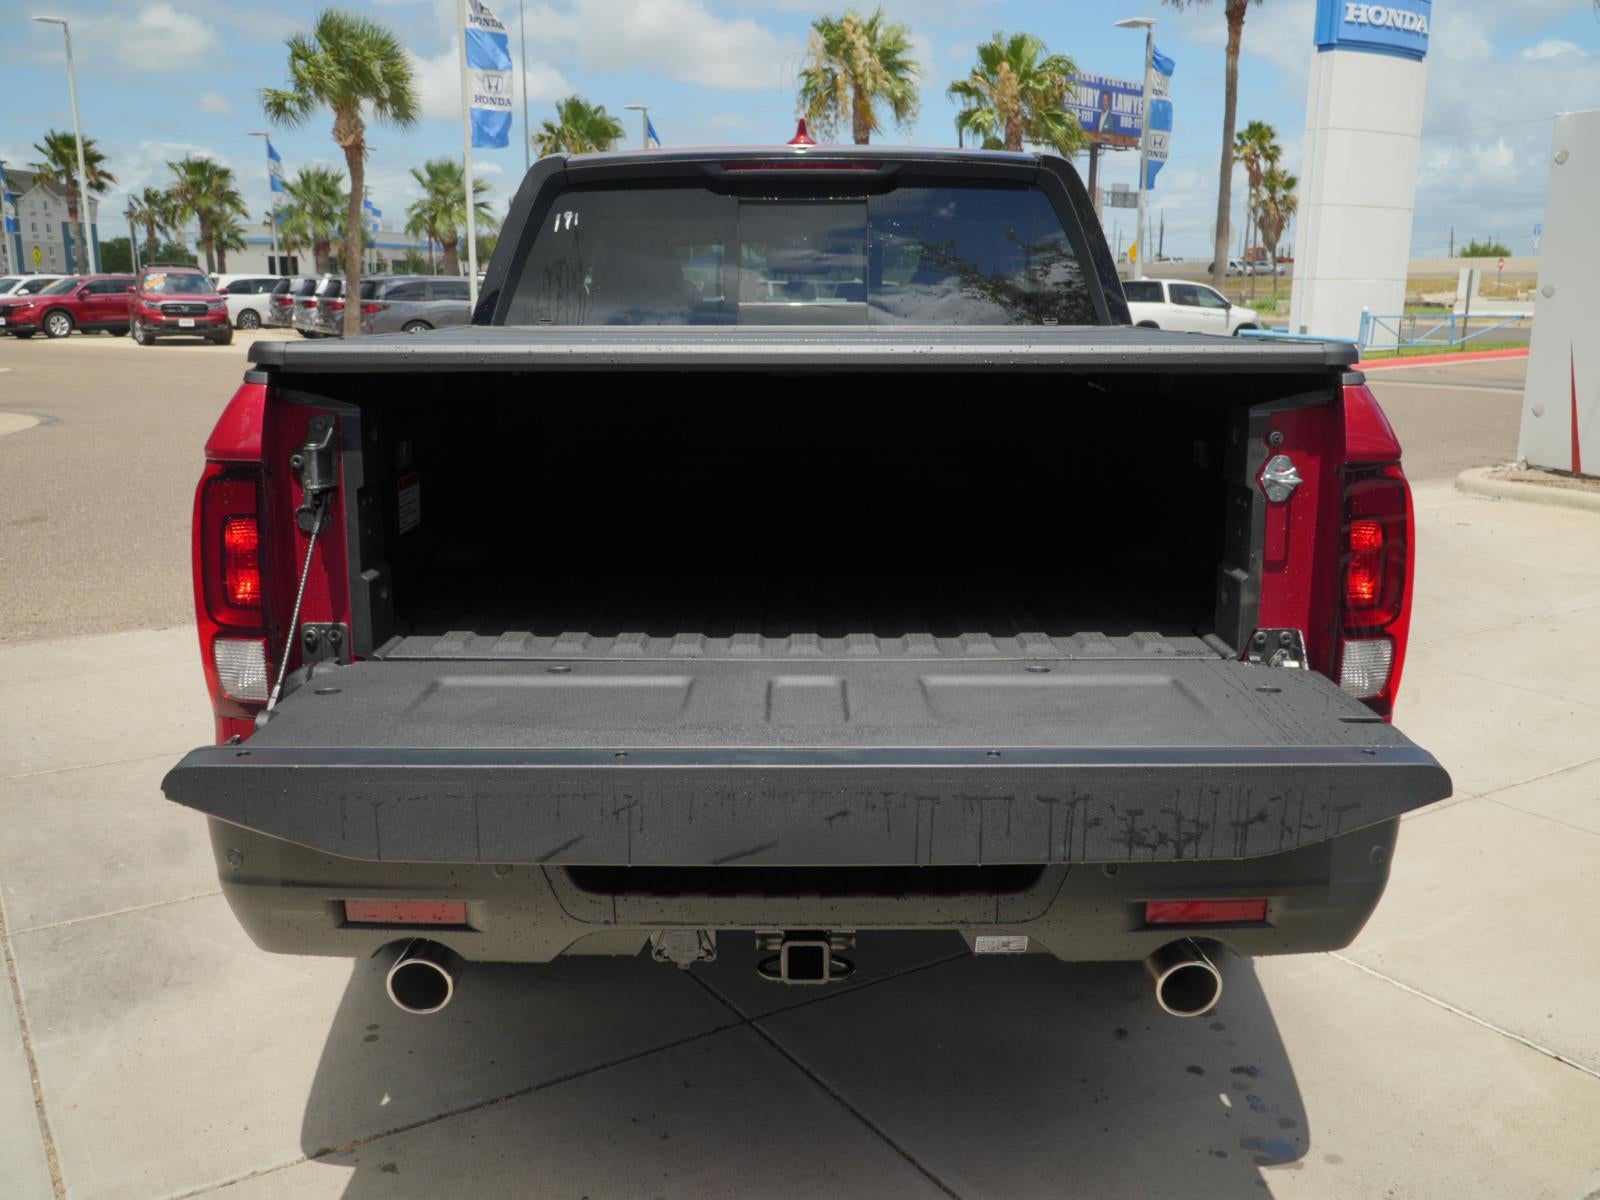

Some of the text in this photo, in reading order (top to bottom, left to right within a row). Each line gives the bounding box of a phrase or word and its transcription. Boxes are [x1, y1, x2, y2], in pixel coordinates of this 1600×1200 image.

[1344, 3, 1429, 35] HONDA
[474, 94, 512, 107] HONDA
[1111, 92, 1143, 115] LAWYE
[554, 211, 578, 232] 191
